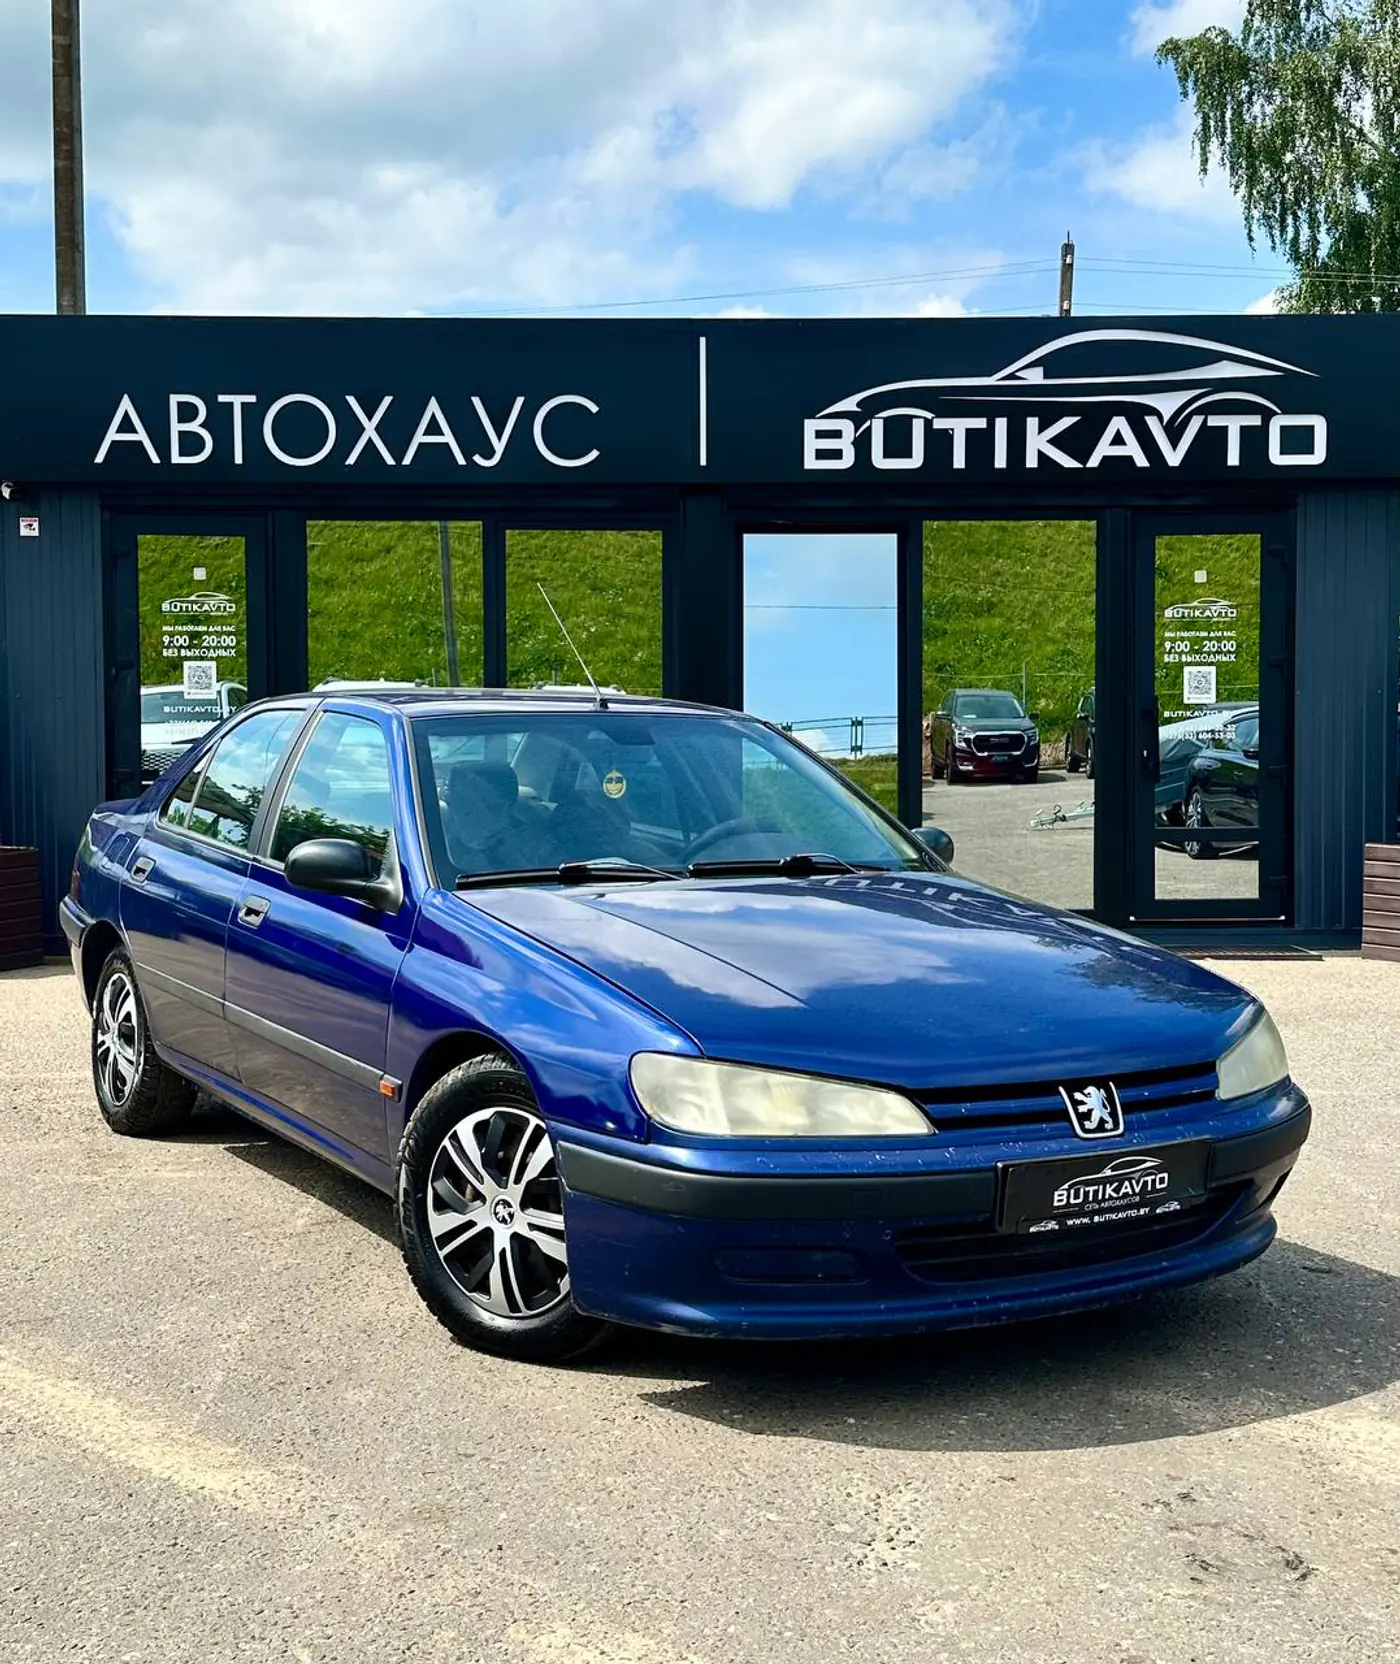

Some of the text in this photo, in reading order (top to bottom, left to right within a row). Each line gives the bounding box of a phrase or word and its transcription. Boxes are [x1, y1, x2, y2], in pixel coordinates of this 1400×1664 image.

[93, 393, 601, 468] АВТОХАУС
[803, 413, 1328, 470] BUTIKAVTO
[161, 602, 236, 612] BUTIKAVTO
[1164, 608, 1237, 618] BUTIKAVTO
[162, 635, 190, 647] 9:00
[201, 635, 236, 647] 20:00
[1164, 641, 1191, 652] 9:00
[1202, 641, 1237, 652] 20:00
[162, 648, 237, 658] БЕЗ ВЫХОДНЫХ
[1164, 654, 1236, 663] БЕЗ ВЫХОДНЫХ
[163, 705, 237, 713] BUTIKAVTO.Y
[1053, 1172, 1169, 1206] BUTIKAVTO
